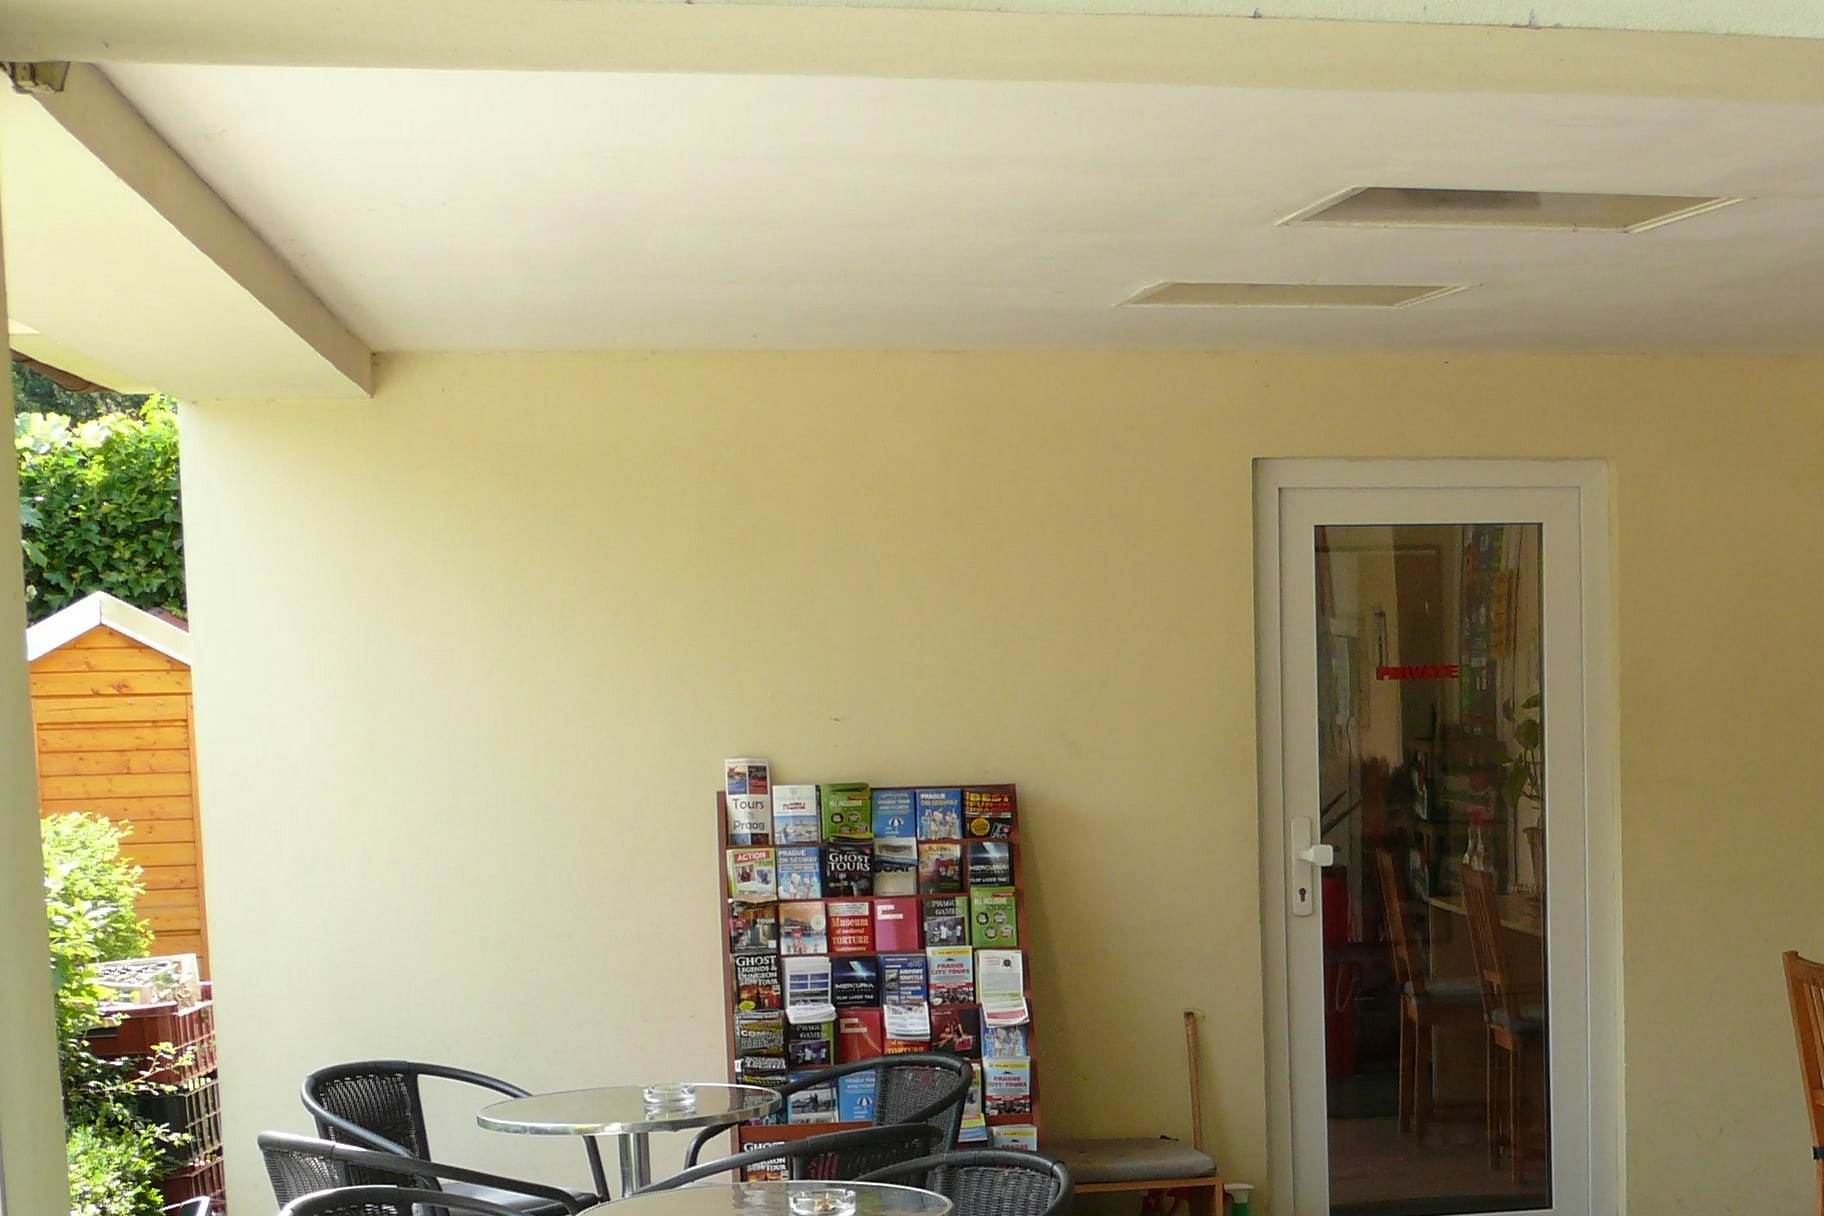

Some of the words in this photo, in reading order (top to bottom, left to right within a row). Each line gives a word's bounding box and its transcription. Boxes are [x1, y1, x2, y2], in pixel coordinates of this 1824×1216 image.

[1376, 664, 1459, 681] PRIVATE
[732, 799, 764, 810] Tours
[733, 821, 765, 831] Praag
[736, 851, 768, 862] ACTION
[829, 852, 870, 863] GHOST
[828, 861, 870, 872] TOURS
[831, 936, 870, 945] TORTURE
[736, 955, 777, 966] GHOST
